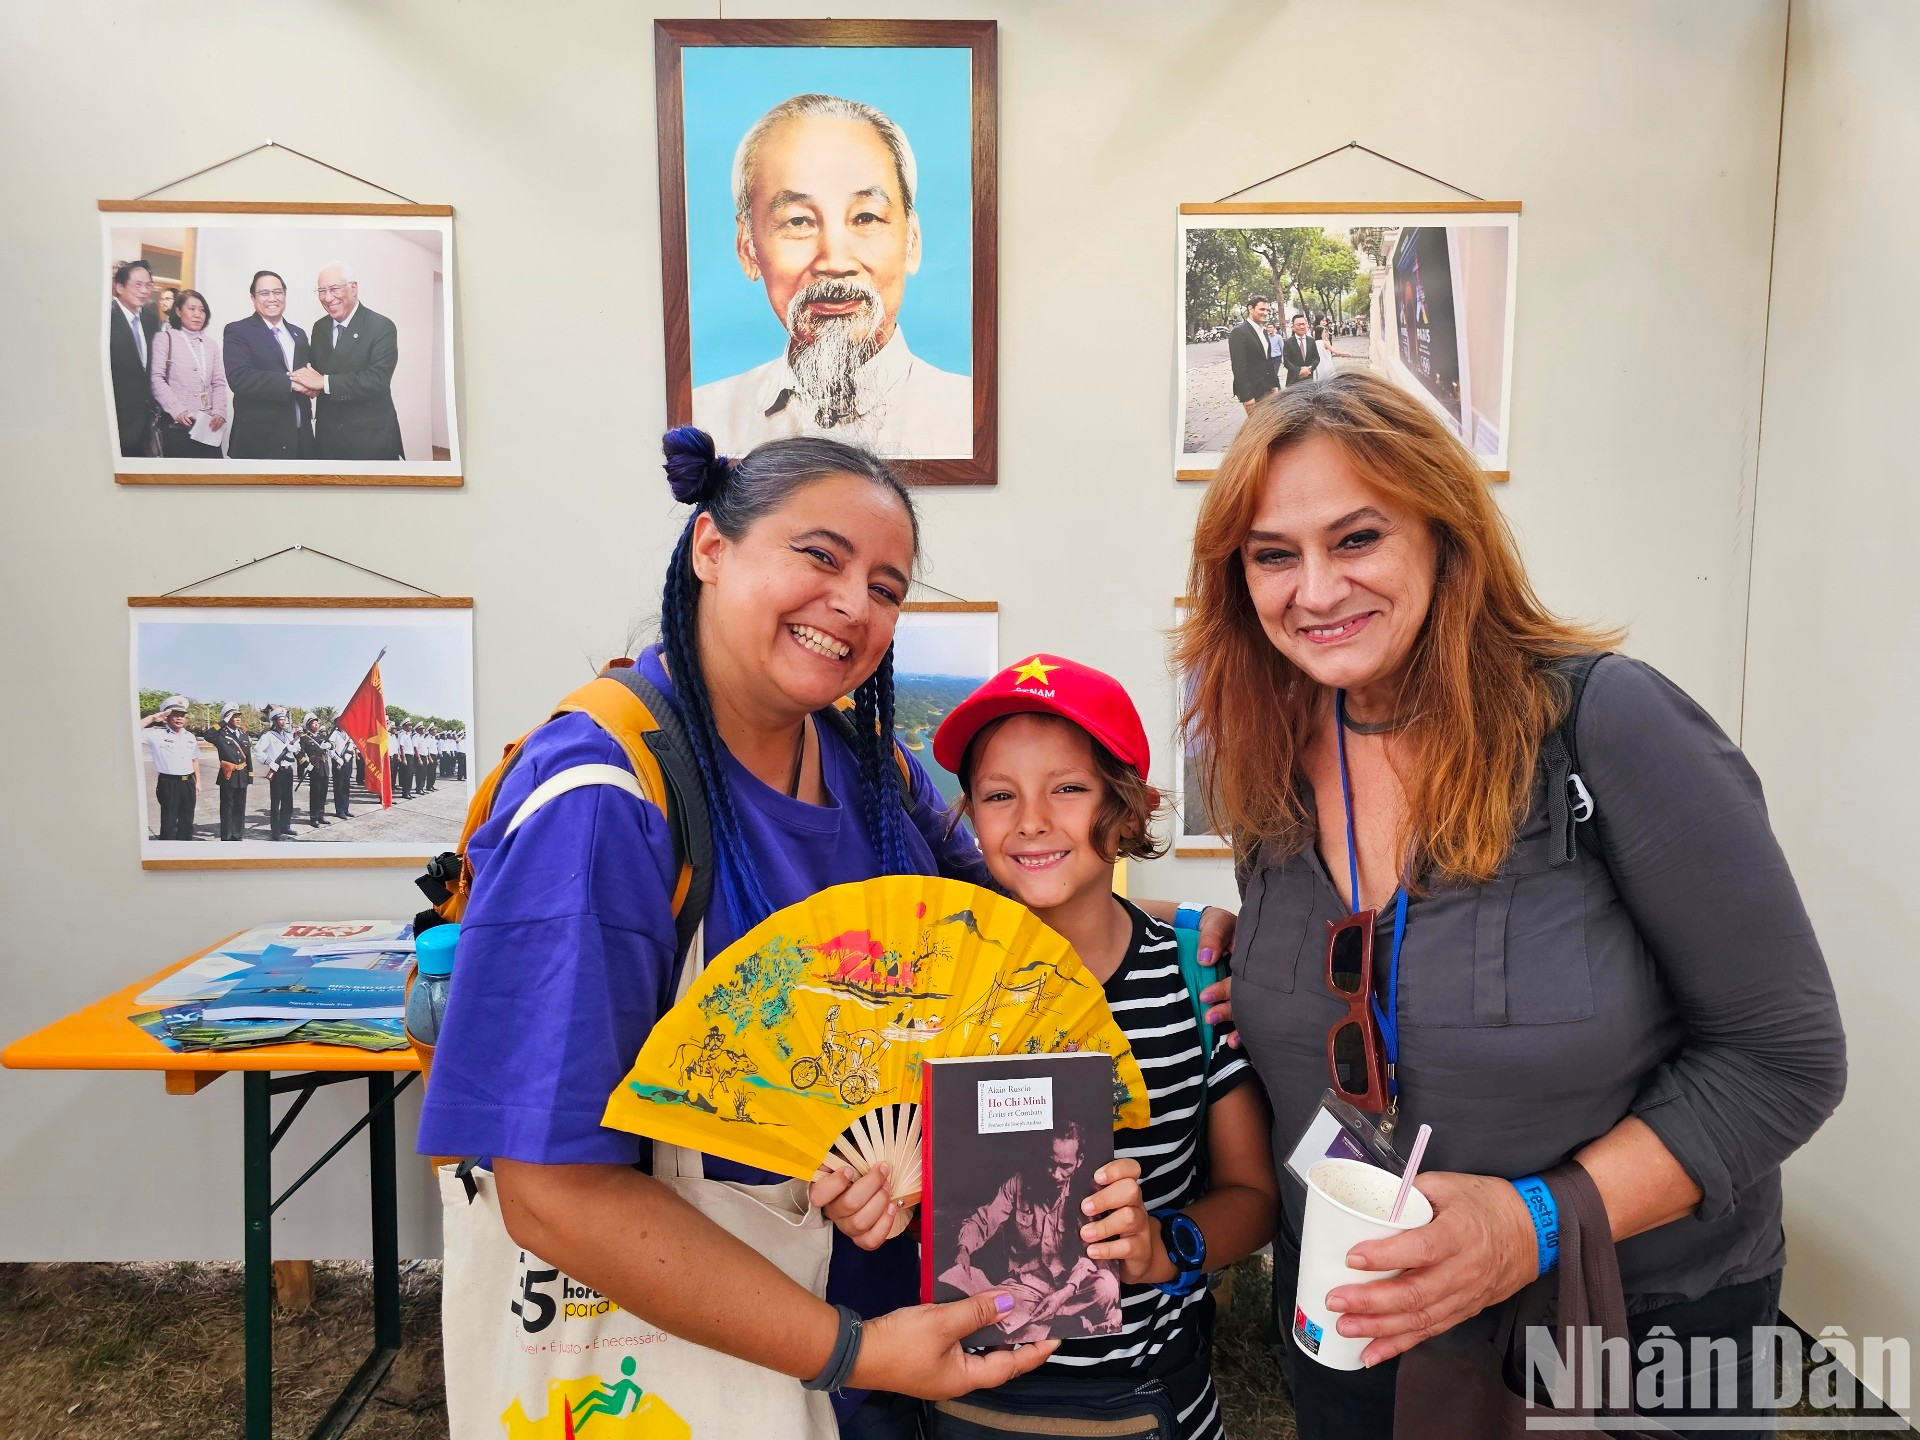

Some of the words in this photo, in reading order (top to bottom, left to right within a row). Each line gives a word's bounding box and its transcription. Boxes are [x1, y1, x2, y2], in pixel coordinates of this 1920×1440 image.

[987, 1086, 1006, 1094] Alain
[1008, 1084, 1031, 1093] Ruscio
[988, 1098, 1002, 1108] Ho
[1004, 1097, 1021, 1107] Chi
[1023, 1095, 1047, 1106] Minh
[1014, 1109, 1043, 1117] Combats
[1524, 1185, 1553, 1228] Festa
[564, 1299, 610, 1323] para
[593, 1334, 600, 1349] É
[602, 1330, 668, 1348] necessário
[550, 1340, 557, 1352] É
[559, 1340, 582, 1355] justo
